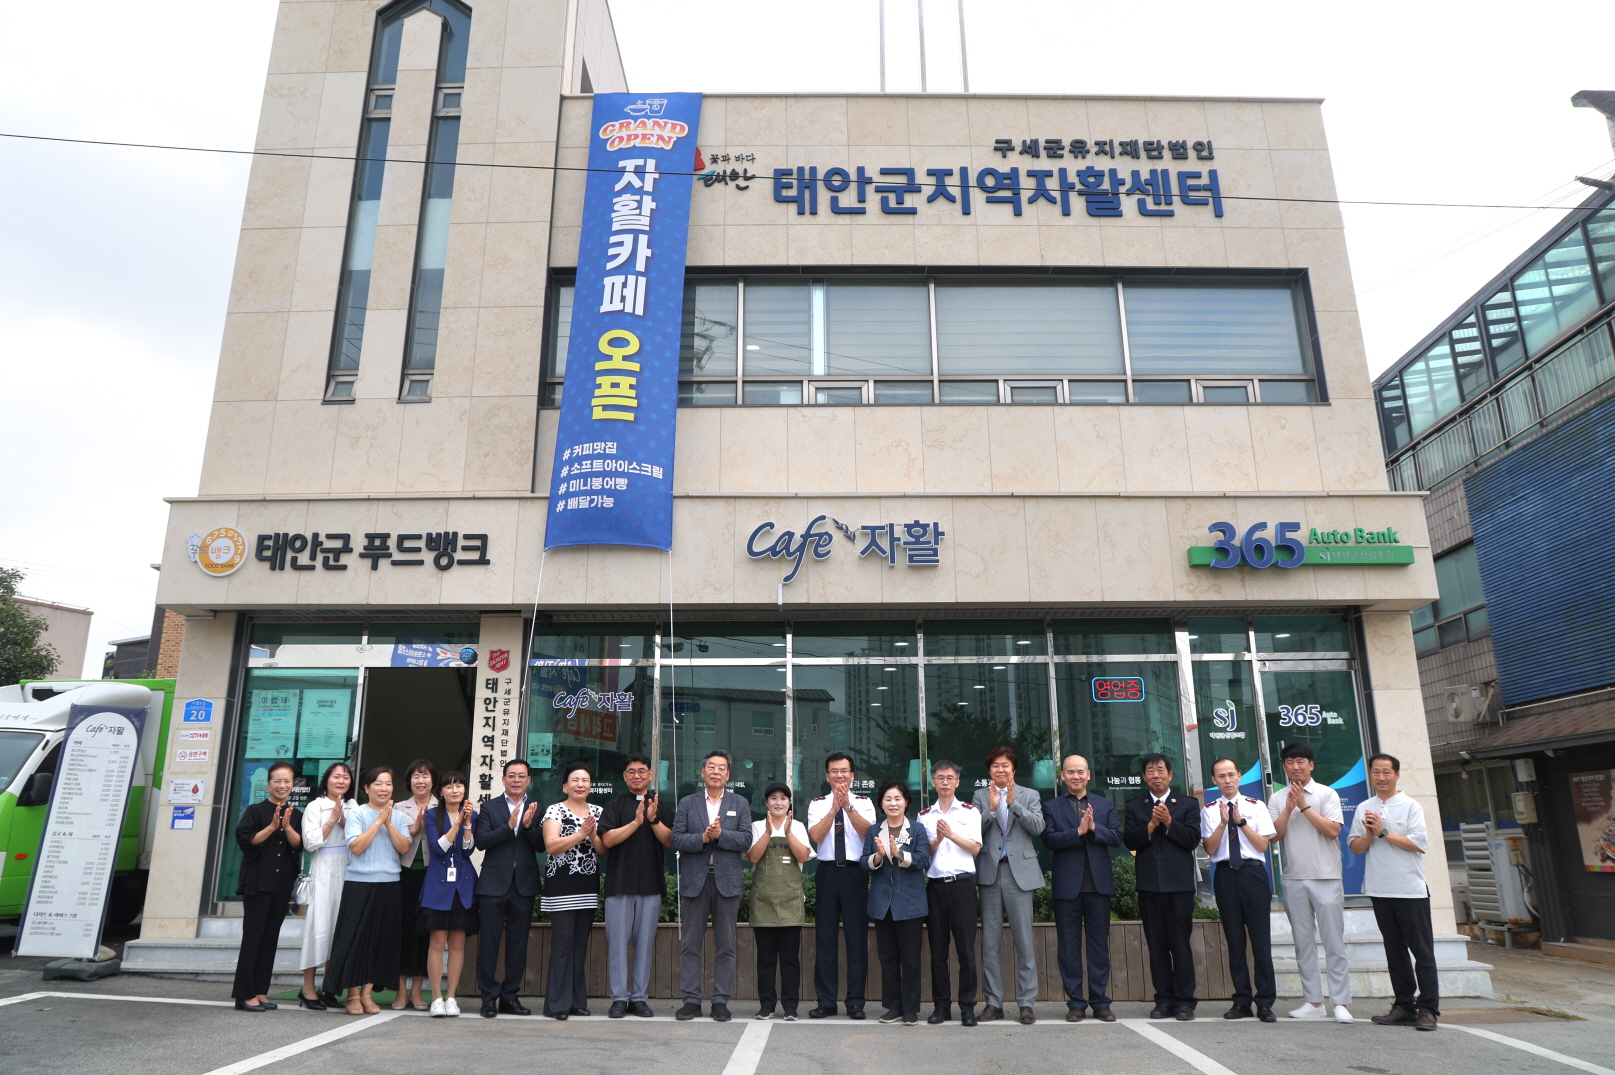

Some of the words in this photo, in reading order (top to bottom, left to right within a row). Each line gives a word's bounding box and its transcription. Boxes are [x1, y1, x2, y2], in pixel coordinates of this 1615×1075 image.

[600, 118, 688, 139] GRAND
[606, 132, 677, 151] OPEN
[993, 138, 1215, 160] 구세군유지재단법인
[773, 165, 1224, 218] 태안군지역자활센터
[600, 158, 659, 316] 자활카페
[592, 329, 640, 422] 오픈
[1208, 521, 1306, 570] 365
[1309, 527, 1352, 545] Auto
[1354, 526, 1400, 544] Bank
[746, 514, 834, 584] Cafe
[859, 519, 946, 567] 자활
[1096, 680, 1142, 699] 영업중
[598, 692, 634, 712] 자활
[190, 710, 205, 720] 20
[1278, 704, 1322, 727] 365
[862, 780, 875, 788] 존중
